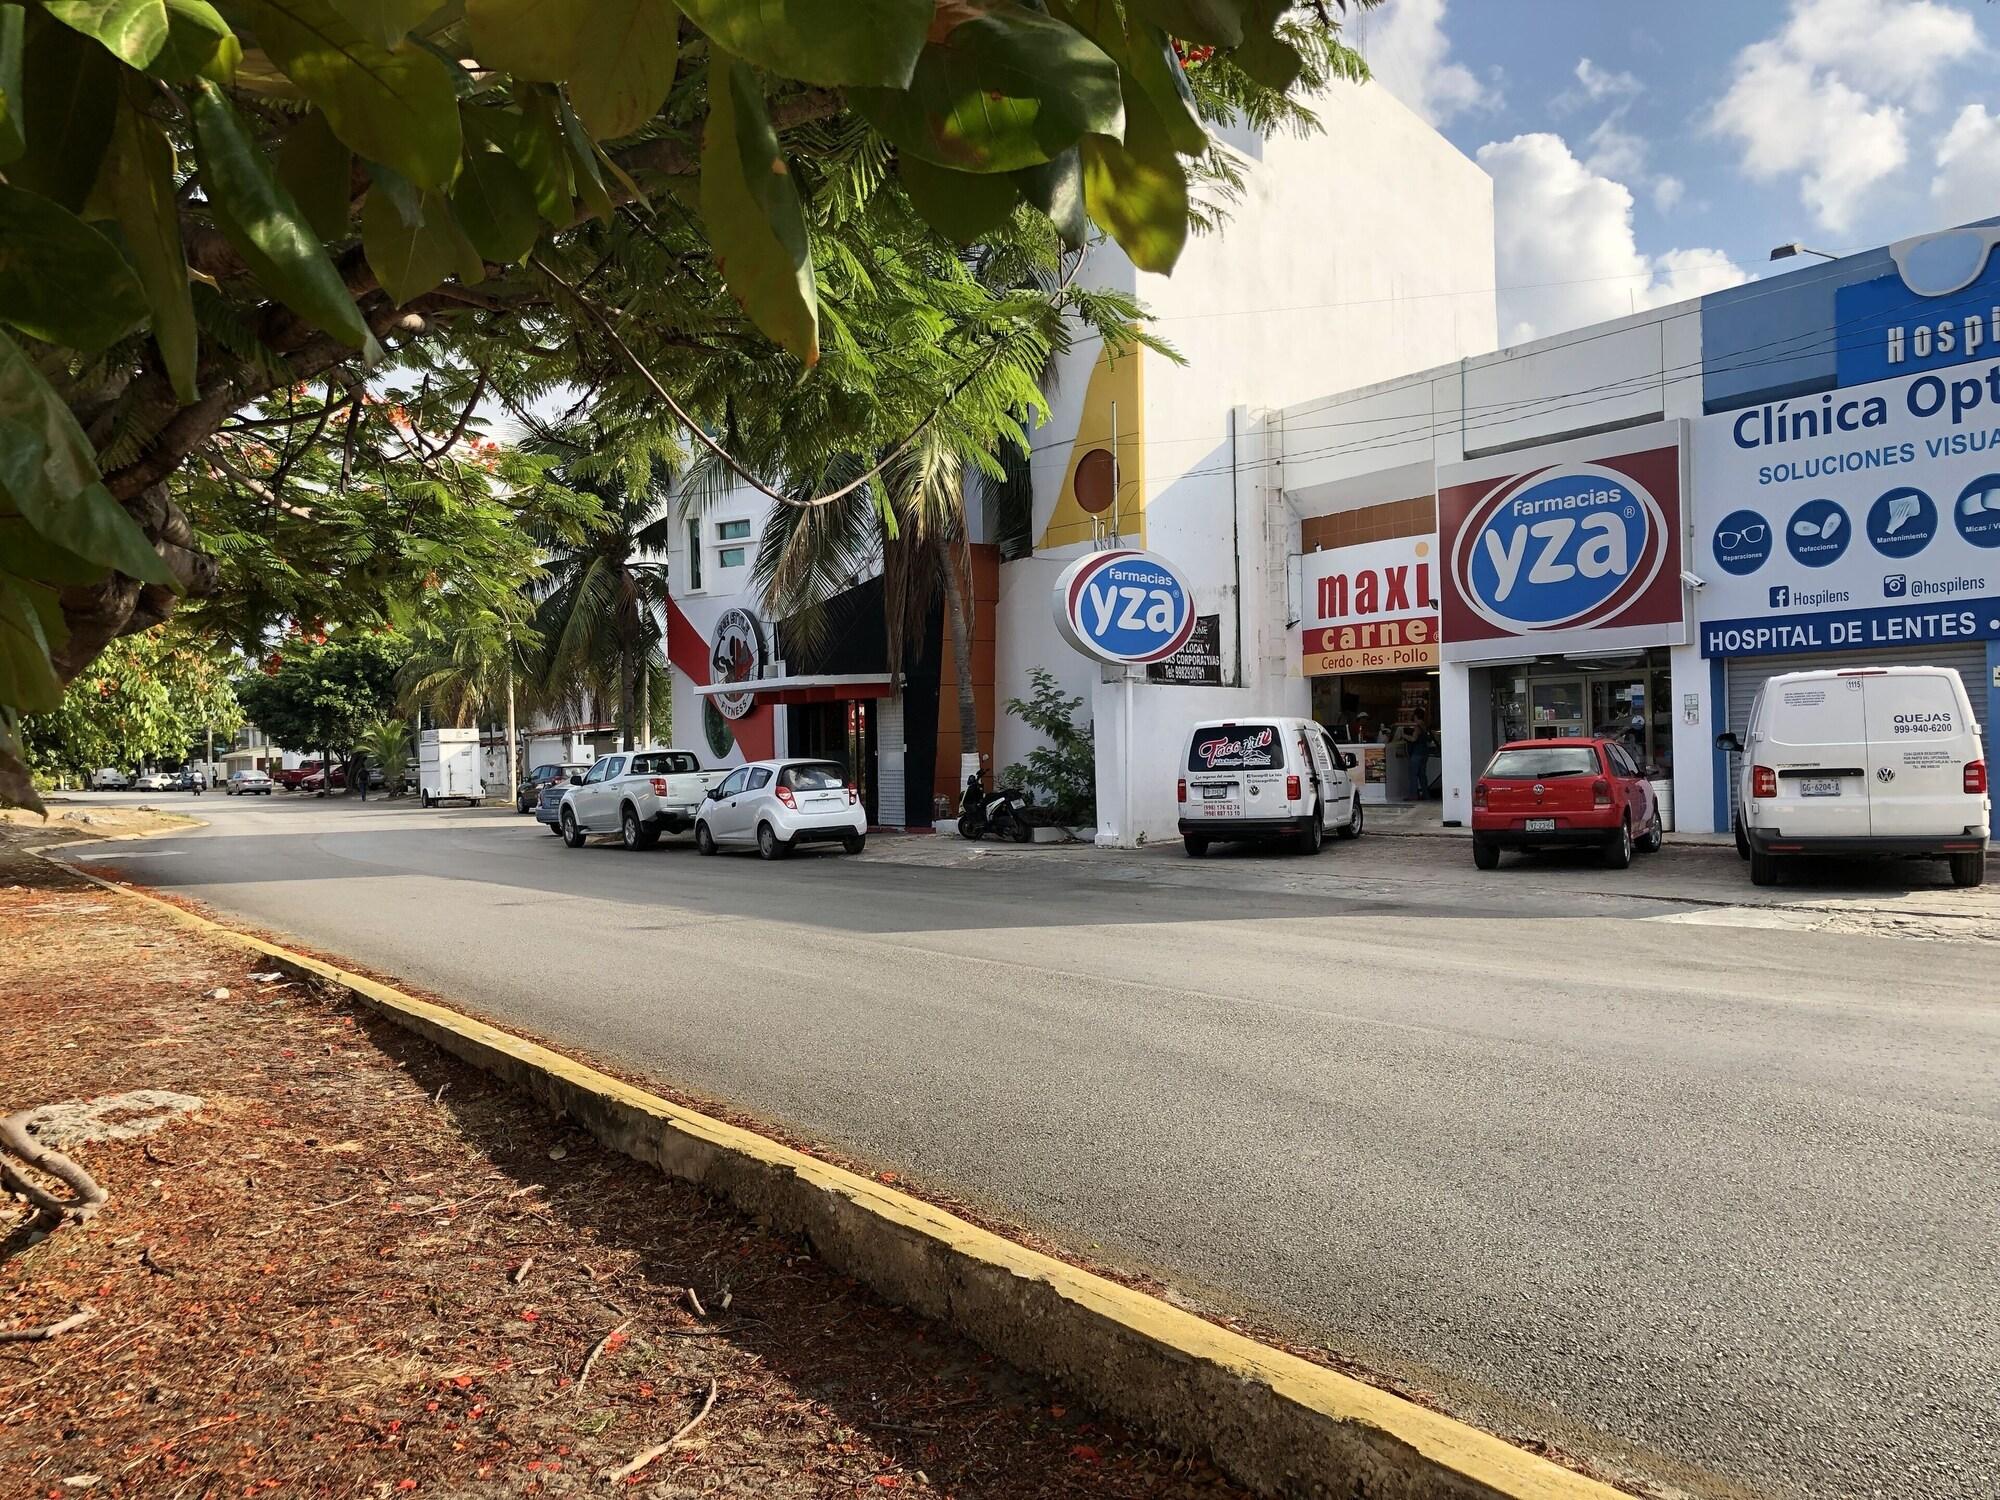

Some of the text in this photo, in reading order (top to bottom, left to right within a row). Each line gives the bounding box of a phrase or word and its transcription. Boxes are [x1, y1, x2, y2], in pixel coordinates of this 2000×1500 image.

[1733, 394, 1887, 449] Clínica
[1759, 428, 2000, 485] SOLUCIONES VISUA
[1876, 532, 1928, 544] Mantenimiento
[1722, 552, 1763, 562] Reparaciones
[1799, 544, 1838, 553] Refacciones
[1318, 541, 1430, 620] maxi
[1911, 576, 1985, 597] @hospilens
[1793, 590, 1850, 607] Hospilens
[1321, 620, 1428, 651] carne
[1709, 612, 1976, 652] HOSPITAL DE LENTES
[1321, 650, 1428, 670] Cerdo Res Pollo
[720, 699, 747, 716] FITNESS
[1894, 713, 1951, 723] QUEJAS
[1894, 724, 1952, 734] 999-940-6200
